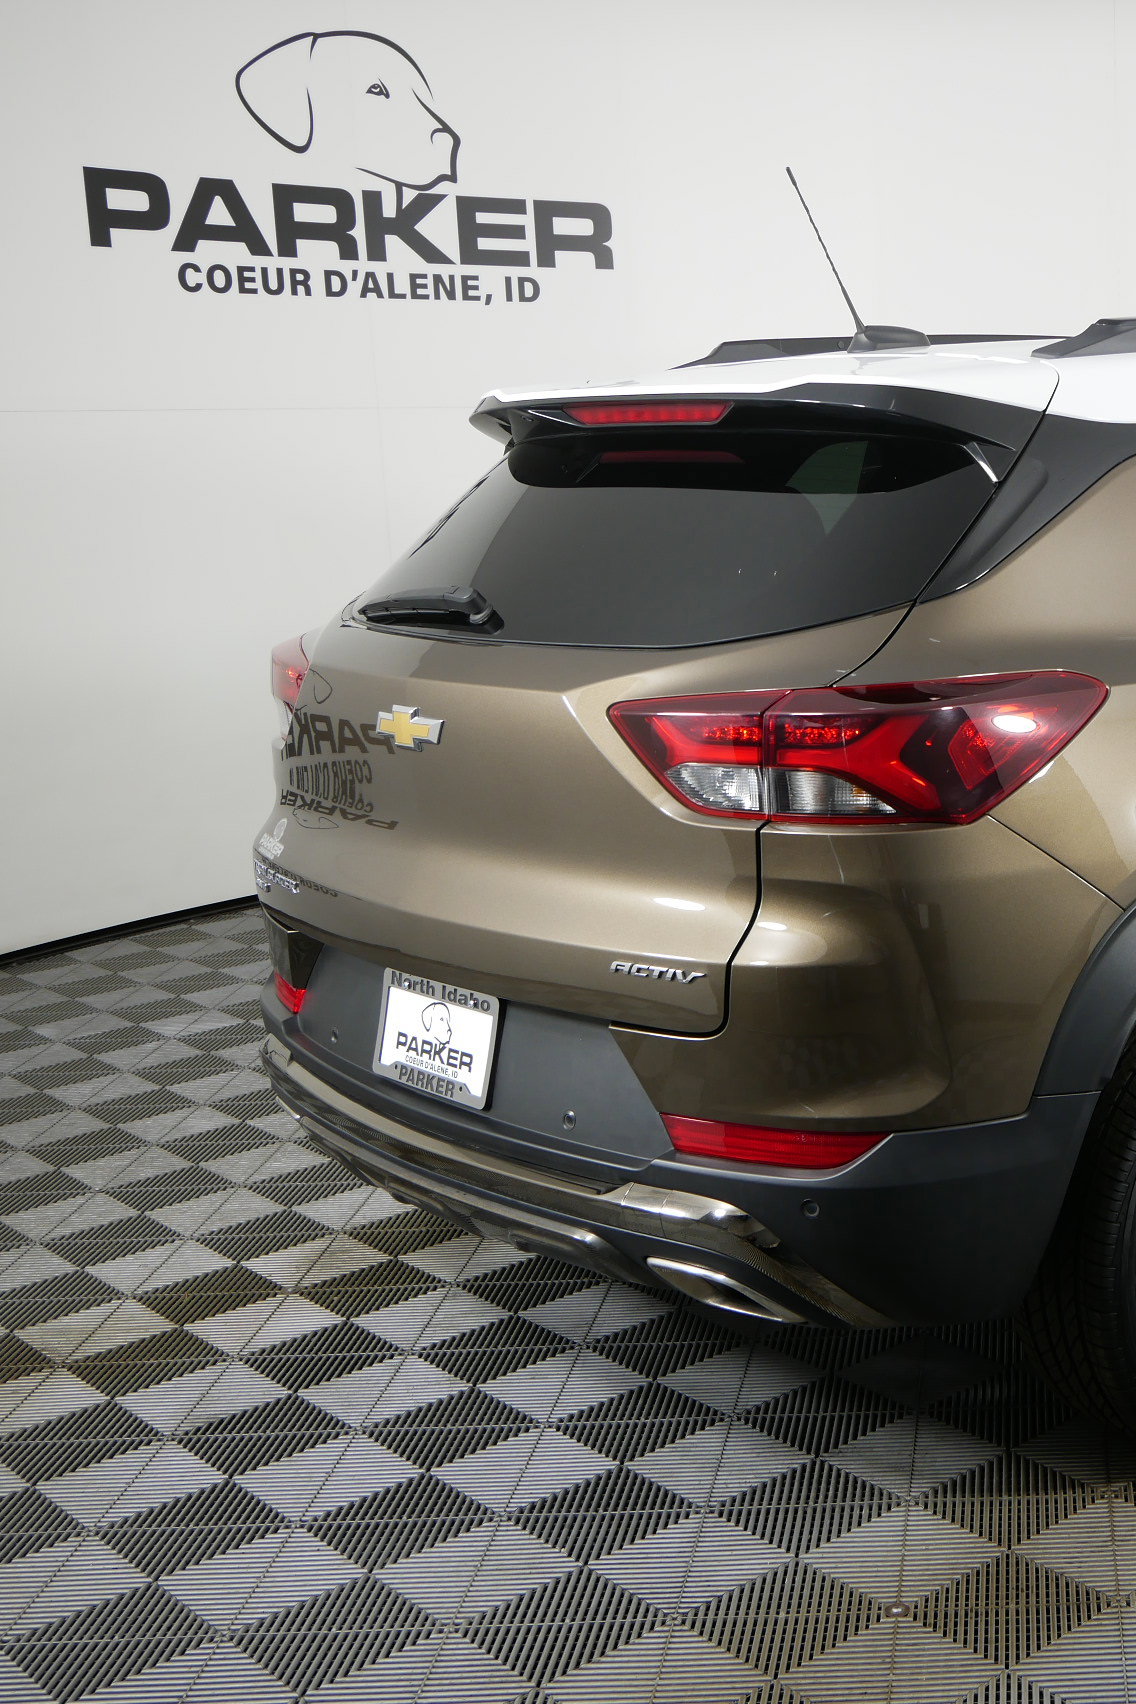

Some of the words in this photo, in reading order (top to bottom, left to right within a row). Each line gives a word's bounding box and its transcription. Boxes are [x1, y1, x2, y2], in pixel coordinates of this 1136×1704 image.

[82, 165, 614, 269] PARKER
[177, 261, 313, 297] COEUR
[323, 269, 493, 306] D'ALENE,
[504, 276, 541, 303] ID
[390, 970, 436, 997] North
[441, 984, 491, 1013] Idaho
[609, 960, 707, 984] ACTIV
[396, 1030, 474, 1073] PARKER
[404, 1054, 424, 1068] COEUR
[450, 1070, 459, 1079] ID
[398, 1064, 456, 1099] PARKER
